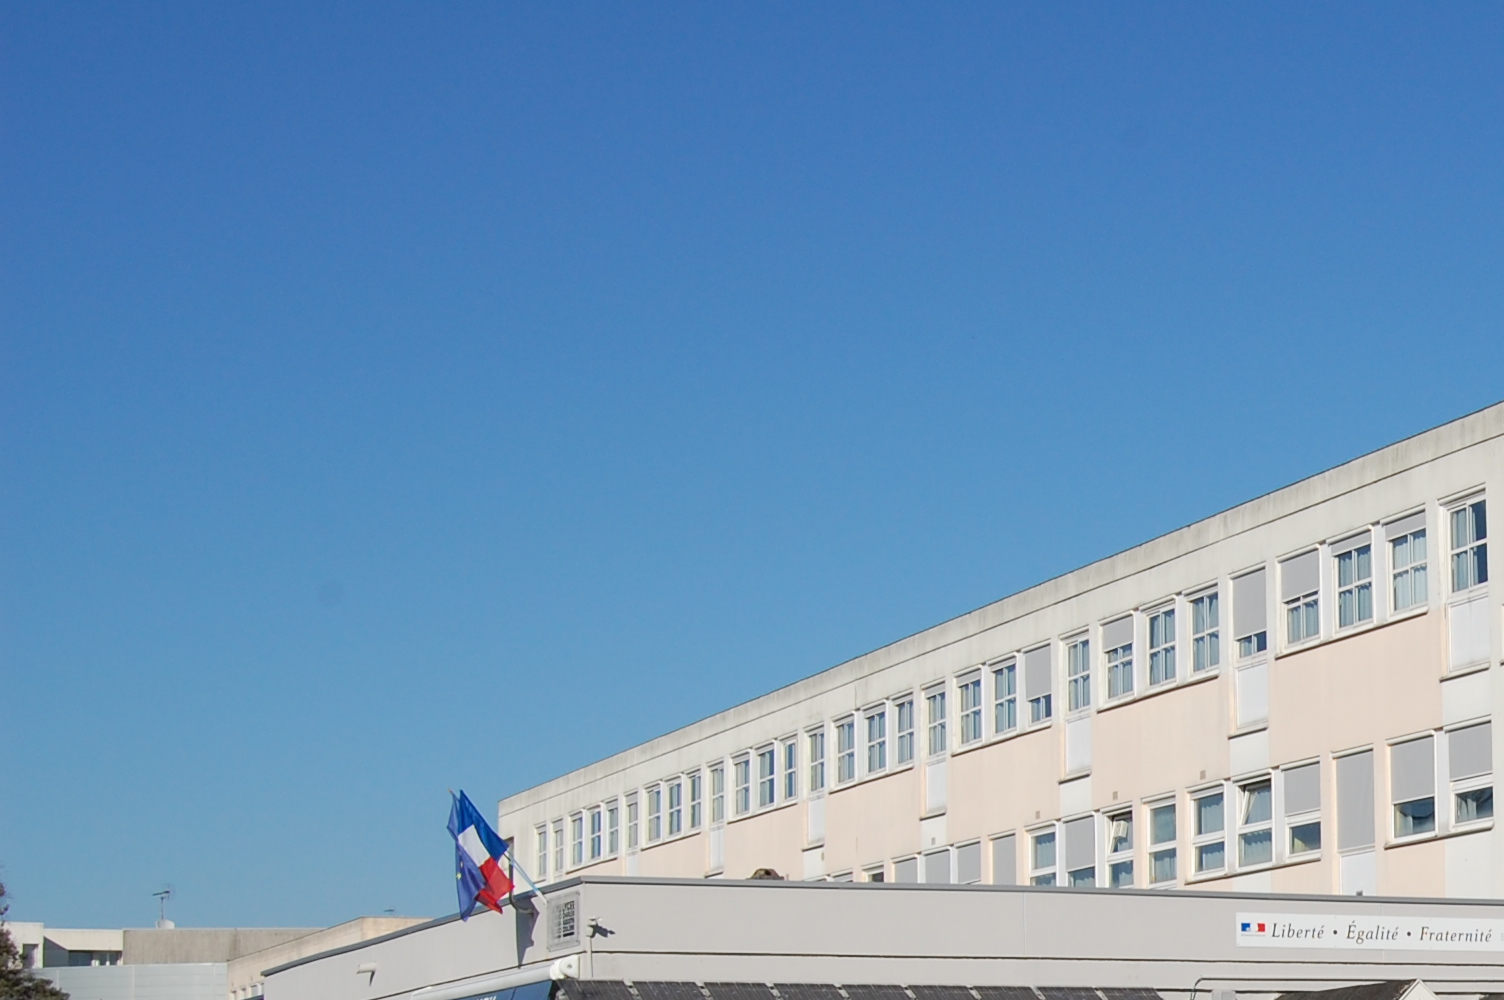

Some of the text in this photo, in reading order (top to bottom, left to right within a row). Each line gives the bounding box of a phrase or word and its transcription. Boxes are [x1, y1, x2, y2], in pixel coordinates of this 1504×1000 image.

[1271, 923, 1325, 940] Liberté
[1346, 920, 1399, 945] Égalité
[1419, 926, 1492, 943] Fraternité
